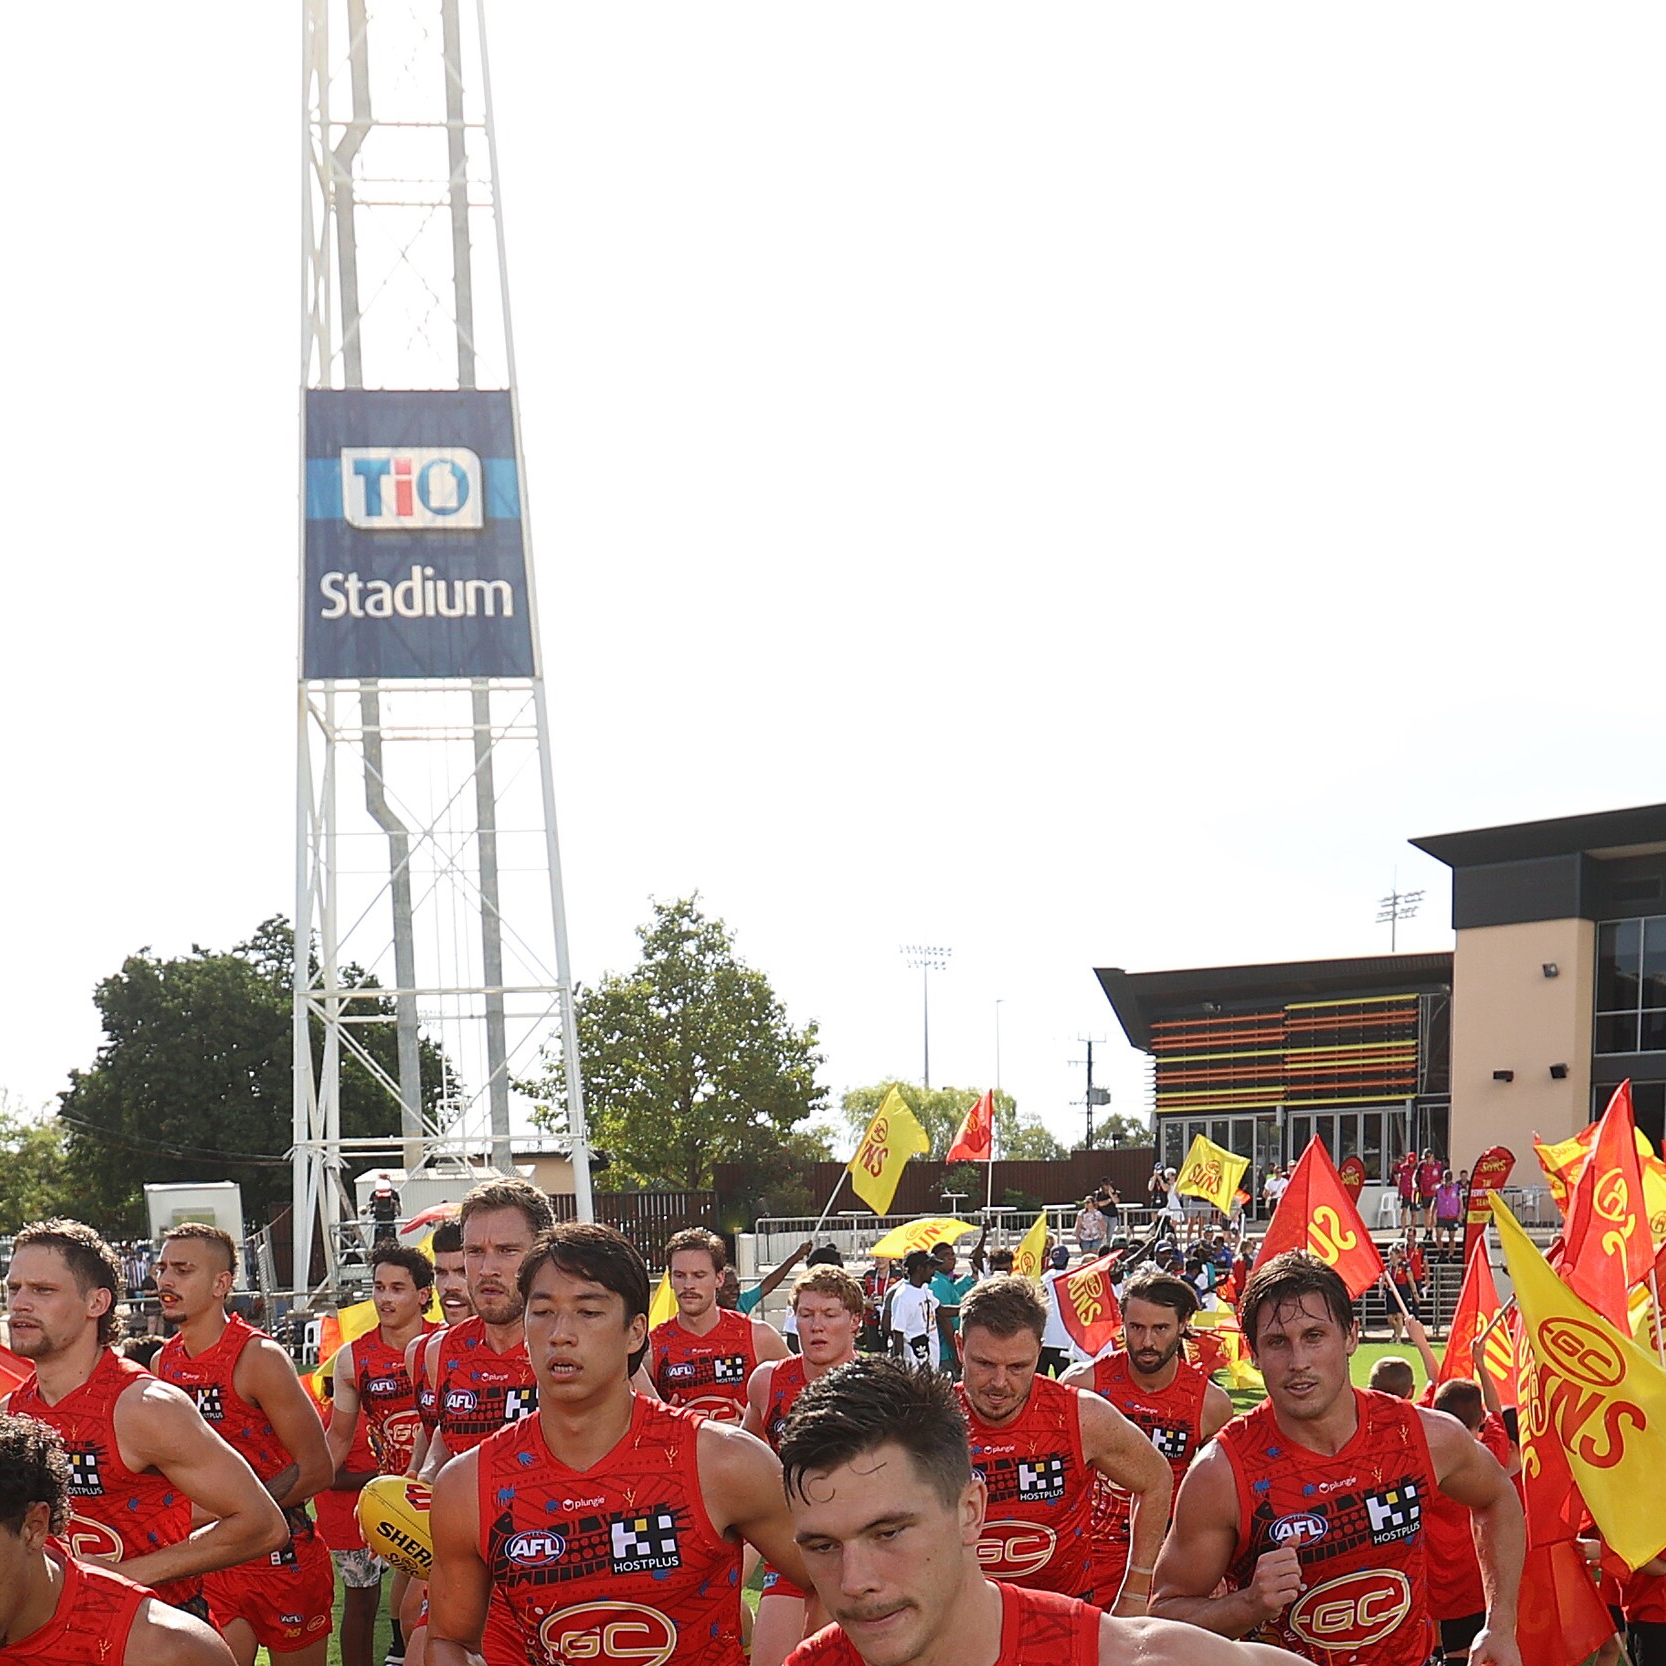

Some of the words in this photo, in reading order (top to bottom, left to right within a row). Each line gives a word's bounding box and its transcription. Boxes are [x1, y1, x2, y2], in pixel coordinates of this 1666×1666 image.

[353, 457, 470, 516] TiO
[319, 565, 514, 619] Stadium
[859, 1140, 889, 1178] NS
[1188, 1164, 1223, 1195] SUNS
[1067, 1273, 1103, 1327] SUNS
[669, 1366, 692, 1377] AFL
[368, 1378, 396, 1392] AFL
[420, 1394, 436, 1406] AF
[445, 1394, 474, 1410] AFL
[1539, 1362, 1648, 1470] NS
[67, 1486, 103, 1496] OSTPLUS
[1329, 1475, 1357, 1492] plungie
[574, 1495, 606, 1511] plungie
[1019, 1487, 1065, 1501] HOSTPLUS
[1275, 1519, 1324, 1541] AFL
[1373, 1520, 1421, 1545] HOSTPLUS
[376, 1520, 432, 1570] SHER
[510, 1538, 561, 1559] AFL
[613, 1555, 680, 1574] HOSTPLUS
[280, 1614, 303, 1624] AFL
